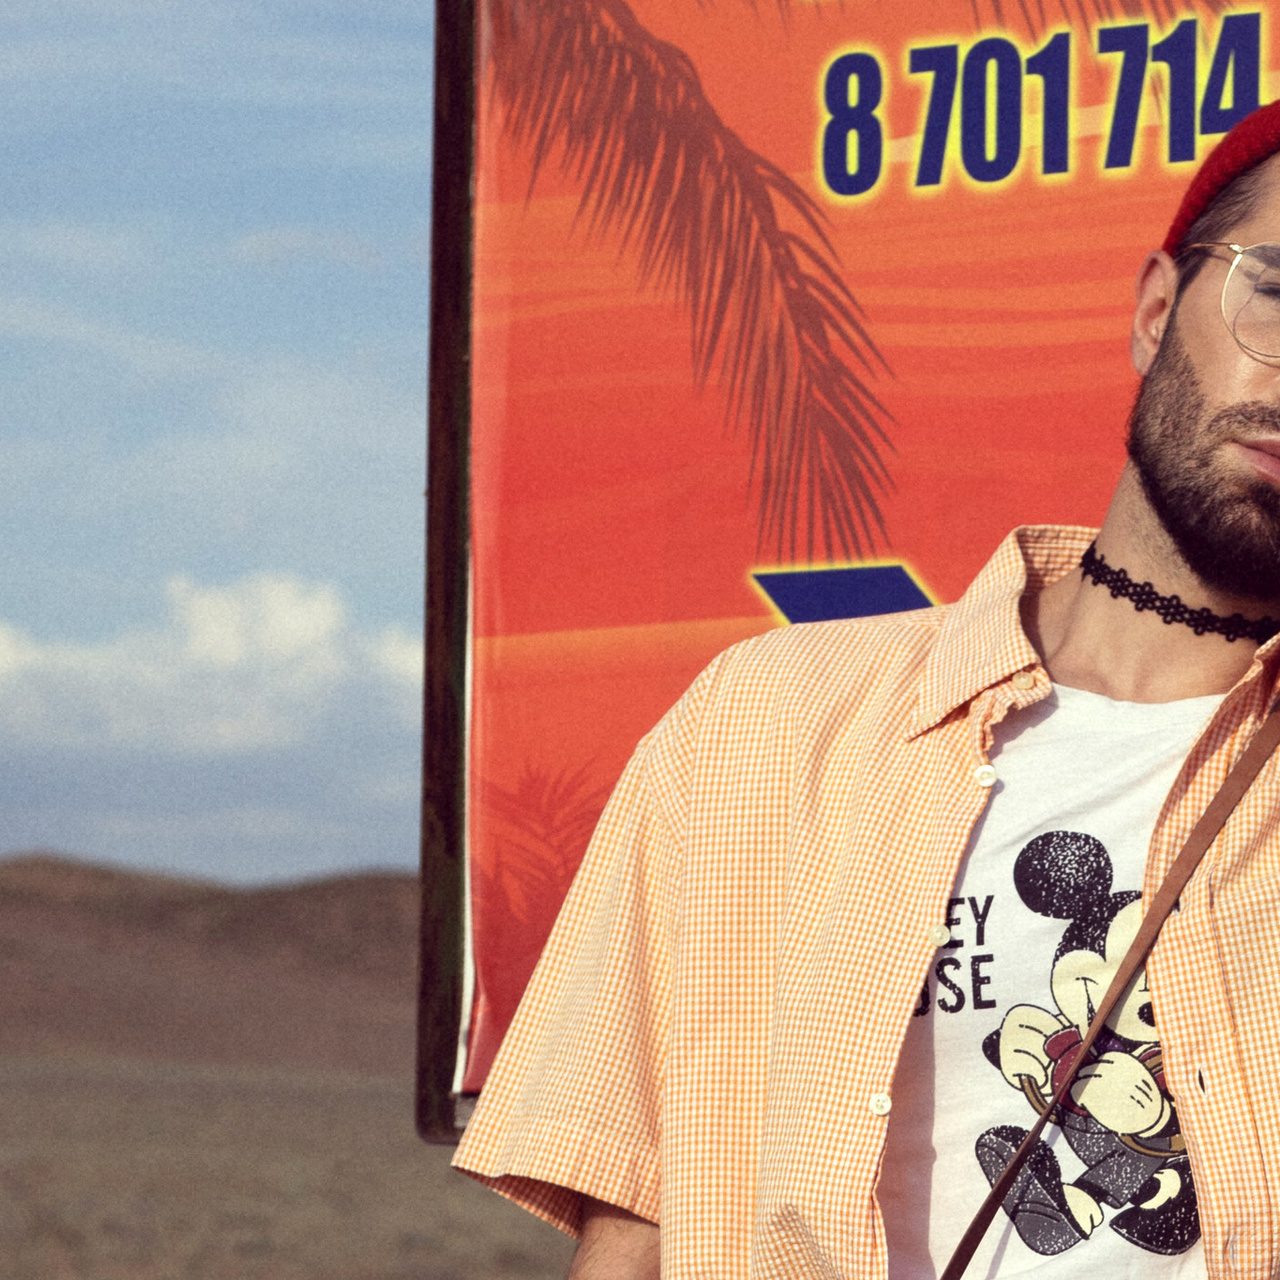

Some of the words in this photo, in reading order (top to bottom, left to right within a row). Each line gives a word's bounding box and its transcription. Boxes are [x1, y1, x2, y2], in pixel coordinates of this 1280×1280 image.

[822, 52, 884, 197] 8
[909, 32, 1071, 188] 701
[1098, 12, 1261, 171] 714
